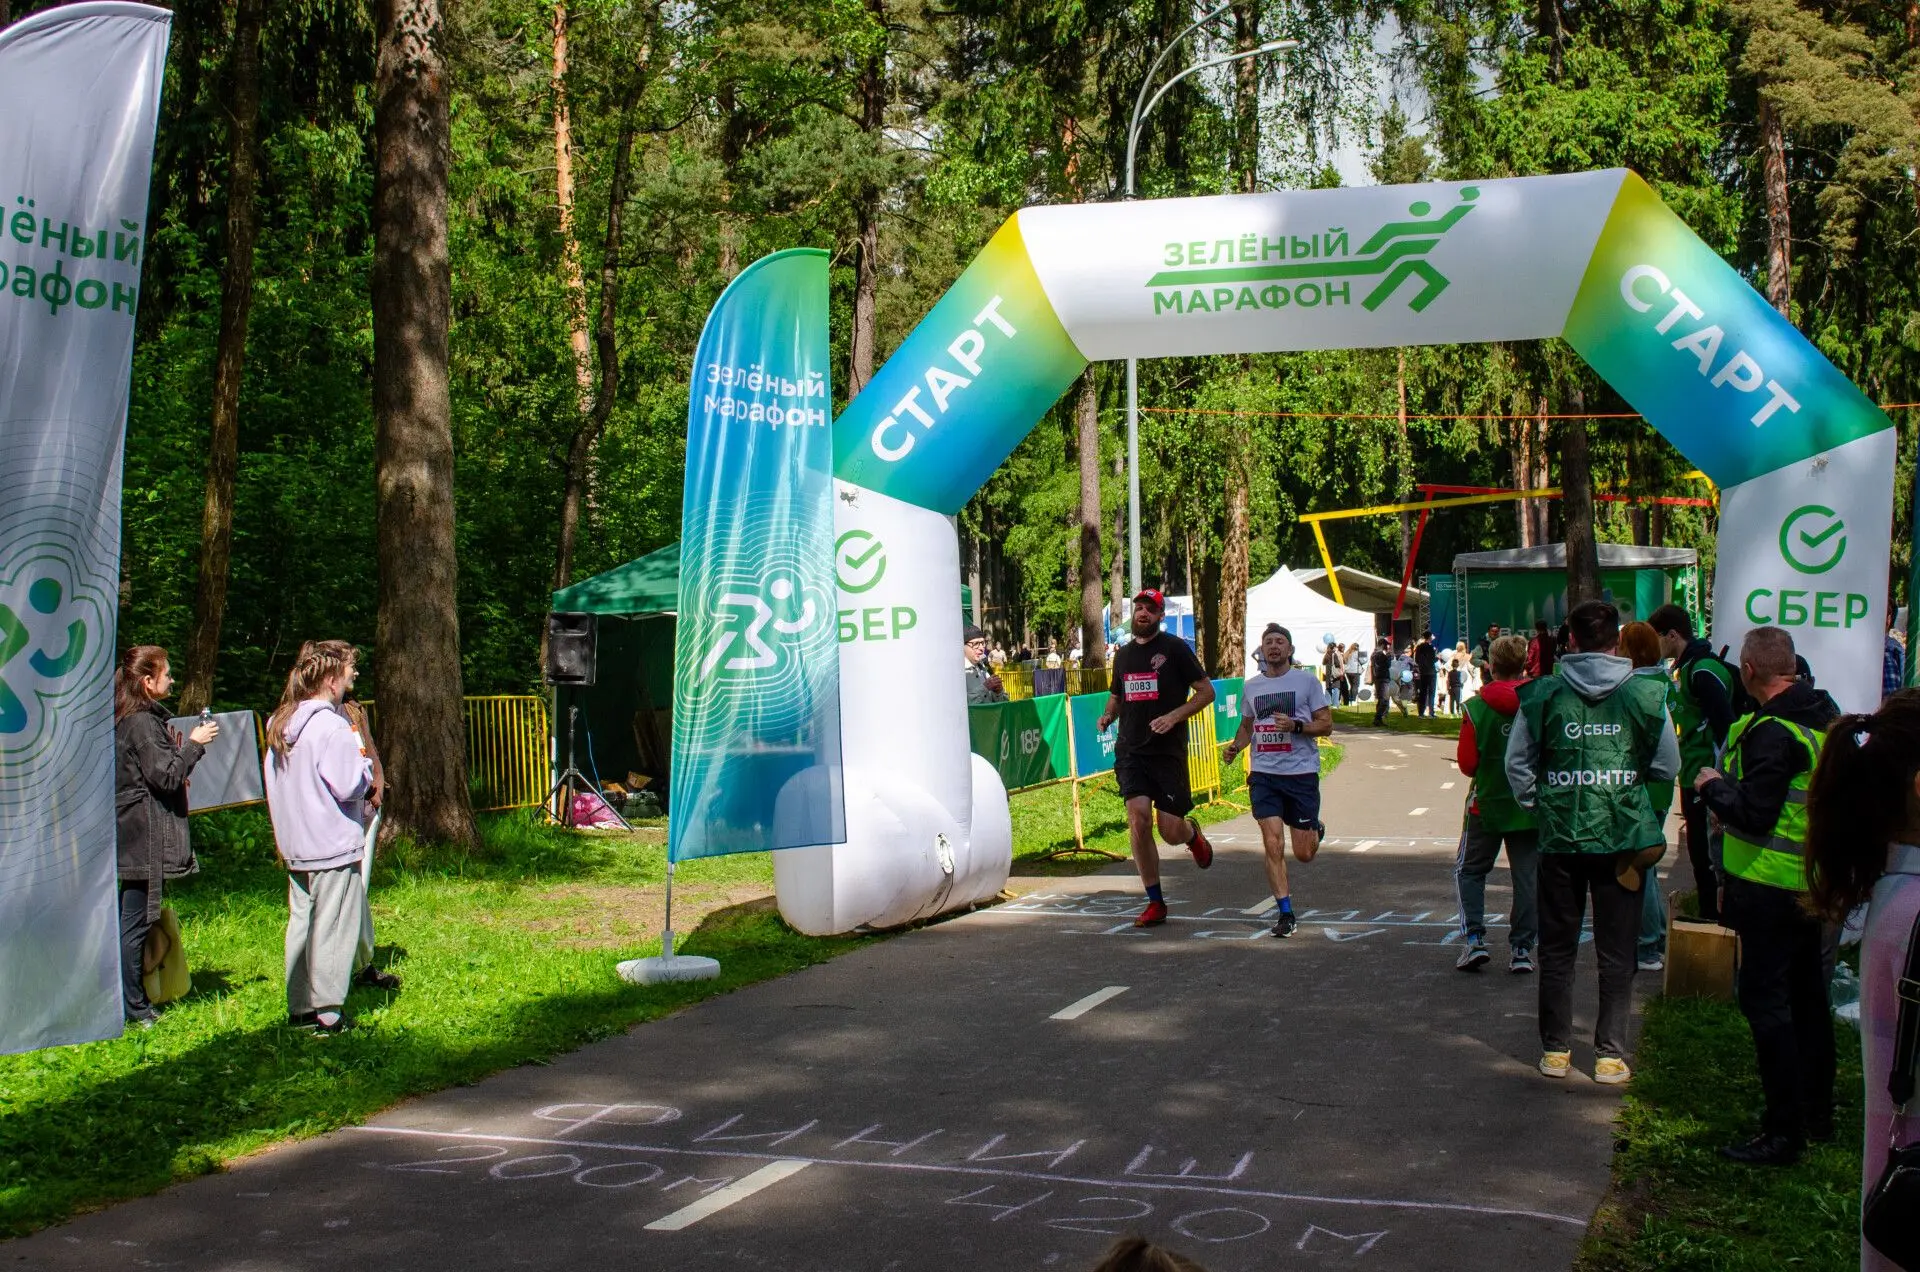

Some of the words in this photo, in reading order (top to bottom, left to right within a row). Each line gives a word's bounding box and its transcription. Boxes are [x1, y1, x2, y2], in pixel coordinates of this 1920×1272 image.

[1164, 226, 1349, 267] ЗЕЛЁНЫЙ
[1153, 281, 1351, 315] МАРАФОН
[1620, 264, 1801, 428] СТАРТ
[706, 362, 825, 398] зелёный
[871, 294, 1018, 462] СТАРТ
[703, 394, 825, 431] марафон
[837, 606, 918, 643] БЕР
[1745, 588, 1868, 629] СБЕР
[1129, 681, 1152, 691] 0083
[1020, 728, 1041, 755] 185
[1261, 733, 1284, 743] 0019
[1583, 723, 1622, 737] СБЕР
[1547, 769, 1639, 787] ВОЛОНТЕР
[533, 1102, 1255, 1181] ФИНИШ
